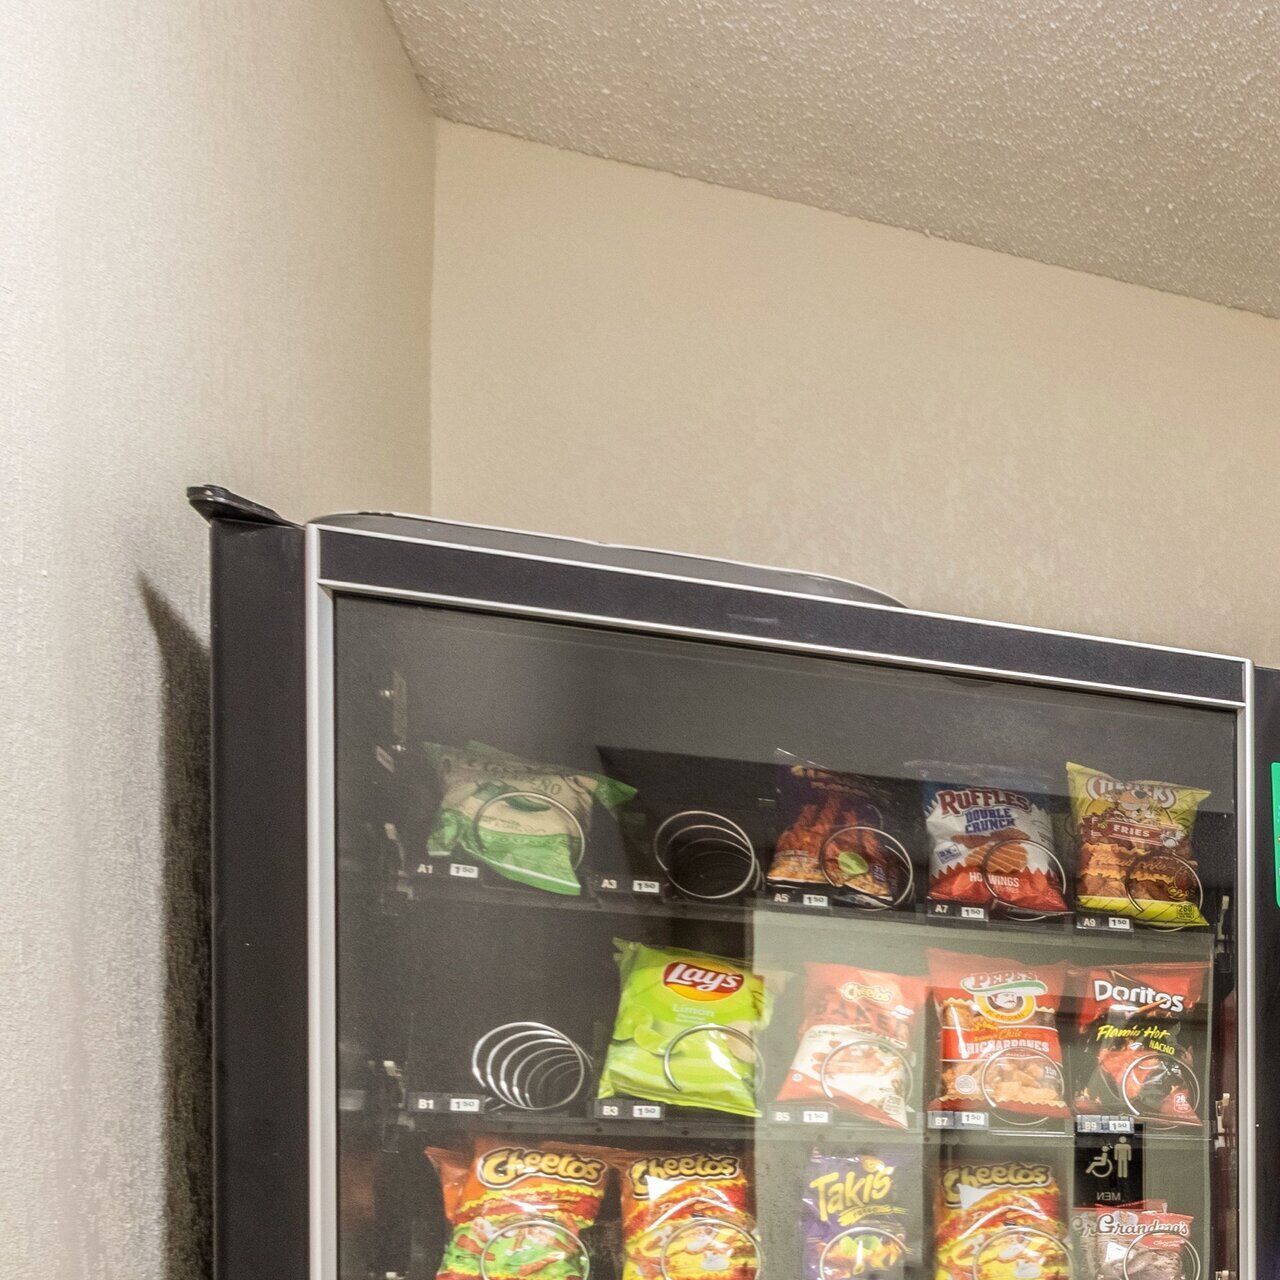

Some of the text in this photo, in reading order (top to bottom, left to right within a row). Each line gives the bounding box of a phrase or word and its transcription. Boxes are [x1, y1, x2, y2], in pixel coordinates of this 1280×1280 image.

[936, 788, 1032, 816] RUFFLES
[965, 808, 1012, 824] DOUBLE
[965, 819, 1016, 835] CRUNCH
[1113, 824, 1151, 838] FRIES
[417, 864, 434, 874] A1
[601, 879, 618, 889] A3
[988, 874, 1020, 888] WINGS
[774, 893, 789, 903] A5
[935, 905, 949, 914] A7
[1083, 918, 1096, 928] A9
[1094, 980, 1185, 1013] Doritos
[1144, 1025, 1171, 1039] Hot
[958, 1039, 1050, 1056] HICHARRONES
[1149, 1039, 1176, 1055] NACHO
[418, 1099, 434, 1110] B1
[602, 1106, 619, 1116] B3
[775, 1111, 791, 1122] B5
[934, 1117, 948, 1126] B7
[1084, 1121, 1097, 1130] B9
[479, 1147, 605, 1187] Cheetos
[628, 1153, 742, 1198] Cheetos
[943, 1163, 1050, 1205] Cheetos
[809, 1171, 894, 1222] Takis
[1098, 1213, 1189, 1236] Grandma's
